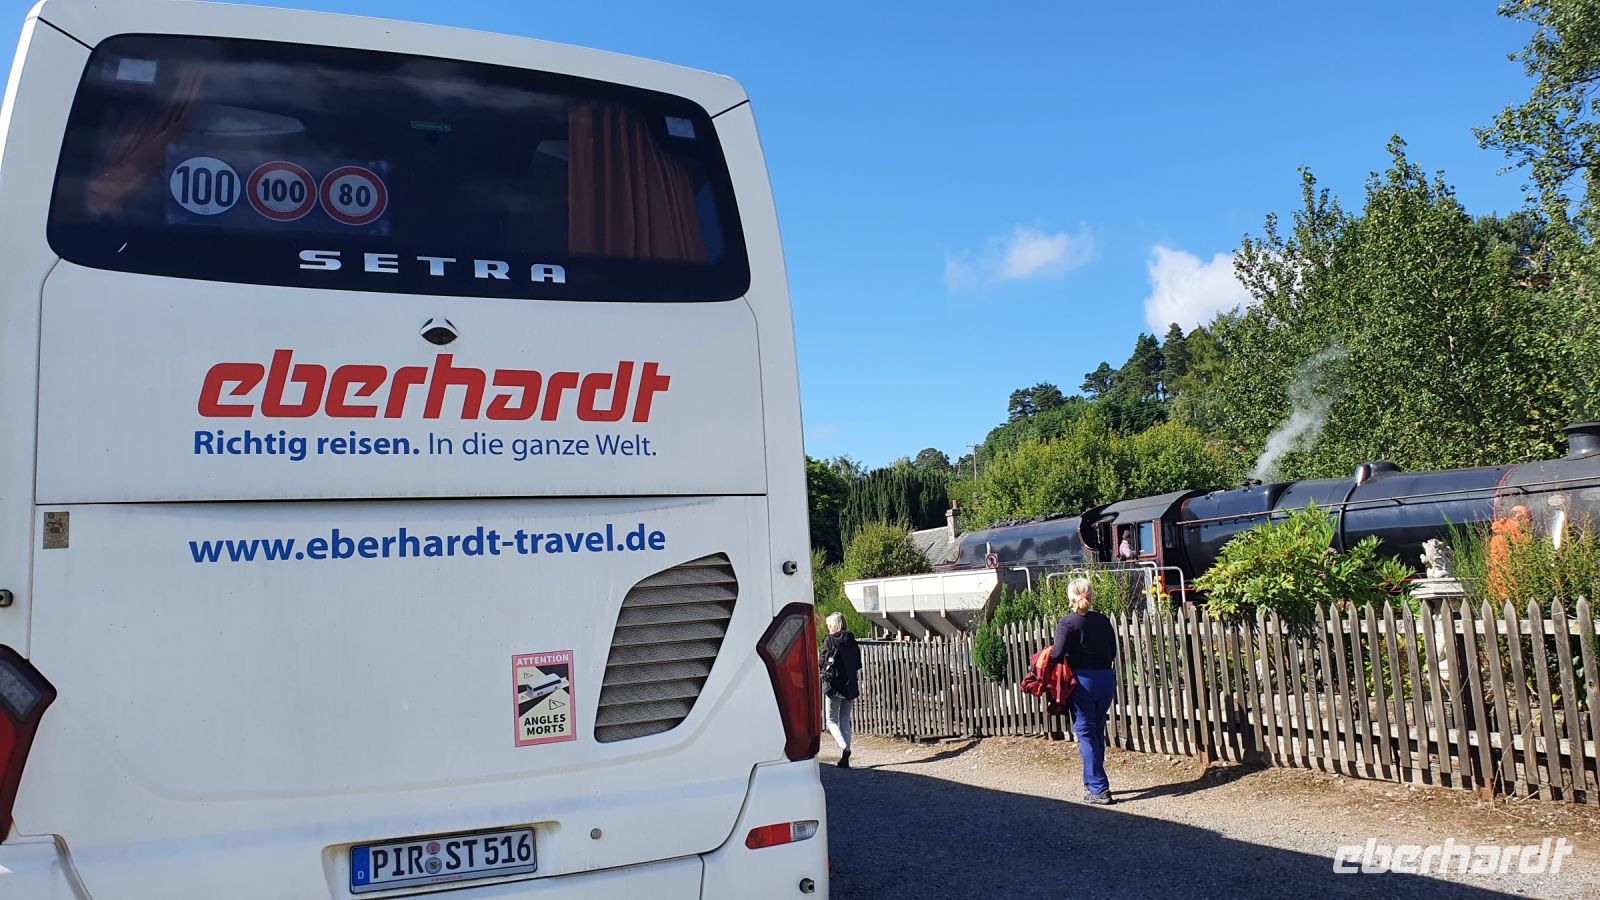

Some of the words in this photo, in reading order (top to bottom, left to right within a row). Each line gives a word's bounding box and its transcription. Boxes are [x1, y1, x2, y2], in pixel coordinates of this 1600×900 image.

[176, 166, 235, 208] 100
[261, 178, 305, 204] 100
[338, 183, 371, 208] 80
[299, 250, 567, 285] SETRA
[198, 348, 671, 422] eberhardt
[194, 429, 307, 462] Richtig
[317, 431, 420, 455] reisen.
[430, 433, 453, 455] In
[462, 431, 504, 456] die
[512, 438, 590, 462] ganze
[595, 433, 657, 457] Welt.
[188, 523, 666, 564] www.eberhardt-travel.de
[517, 654, 569, 666] ATTENTION
[524, 714, 566, 726] ANGLES
[526, 724, 565, 736] MORTS
[371, 845, 425, 880] PIR
[445, 838, 479, 871] ST
[483, 833, 531, 866] 516
